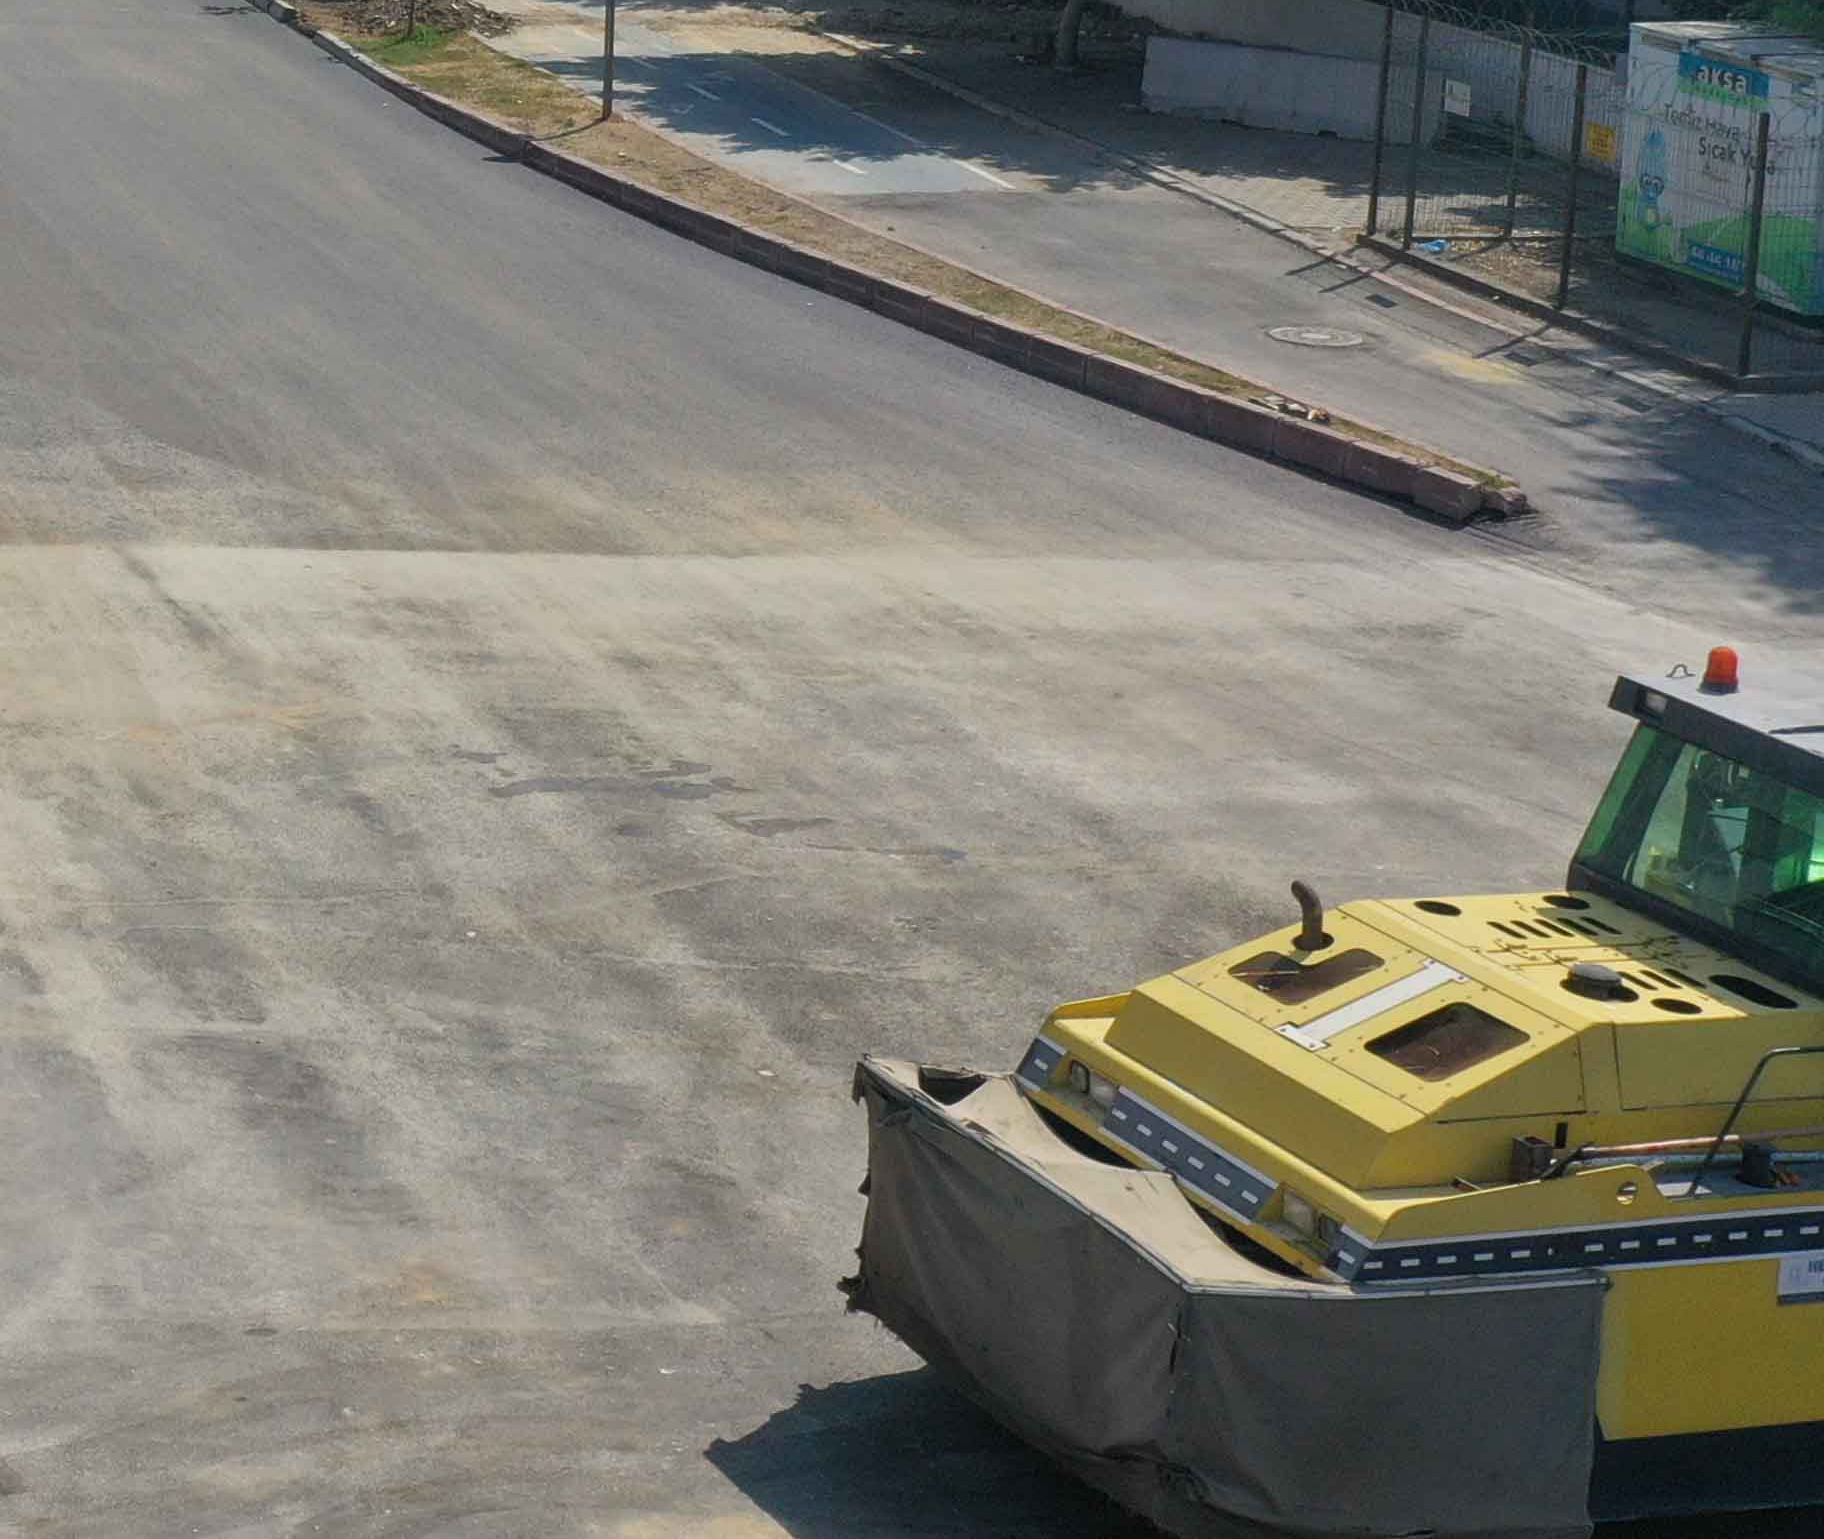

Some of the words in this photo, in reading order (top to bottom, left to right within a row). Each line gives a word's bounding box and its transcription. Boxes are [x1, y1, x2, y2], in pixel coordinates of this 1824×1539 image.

[1696, 64, 1748, 94] aksa
[1664, 103, 1702, 133] Temiz
[1698, 137, 1738, 161] Sıcak
[1740, 148, 1776, 177] Yua
